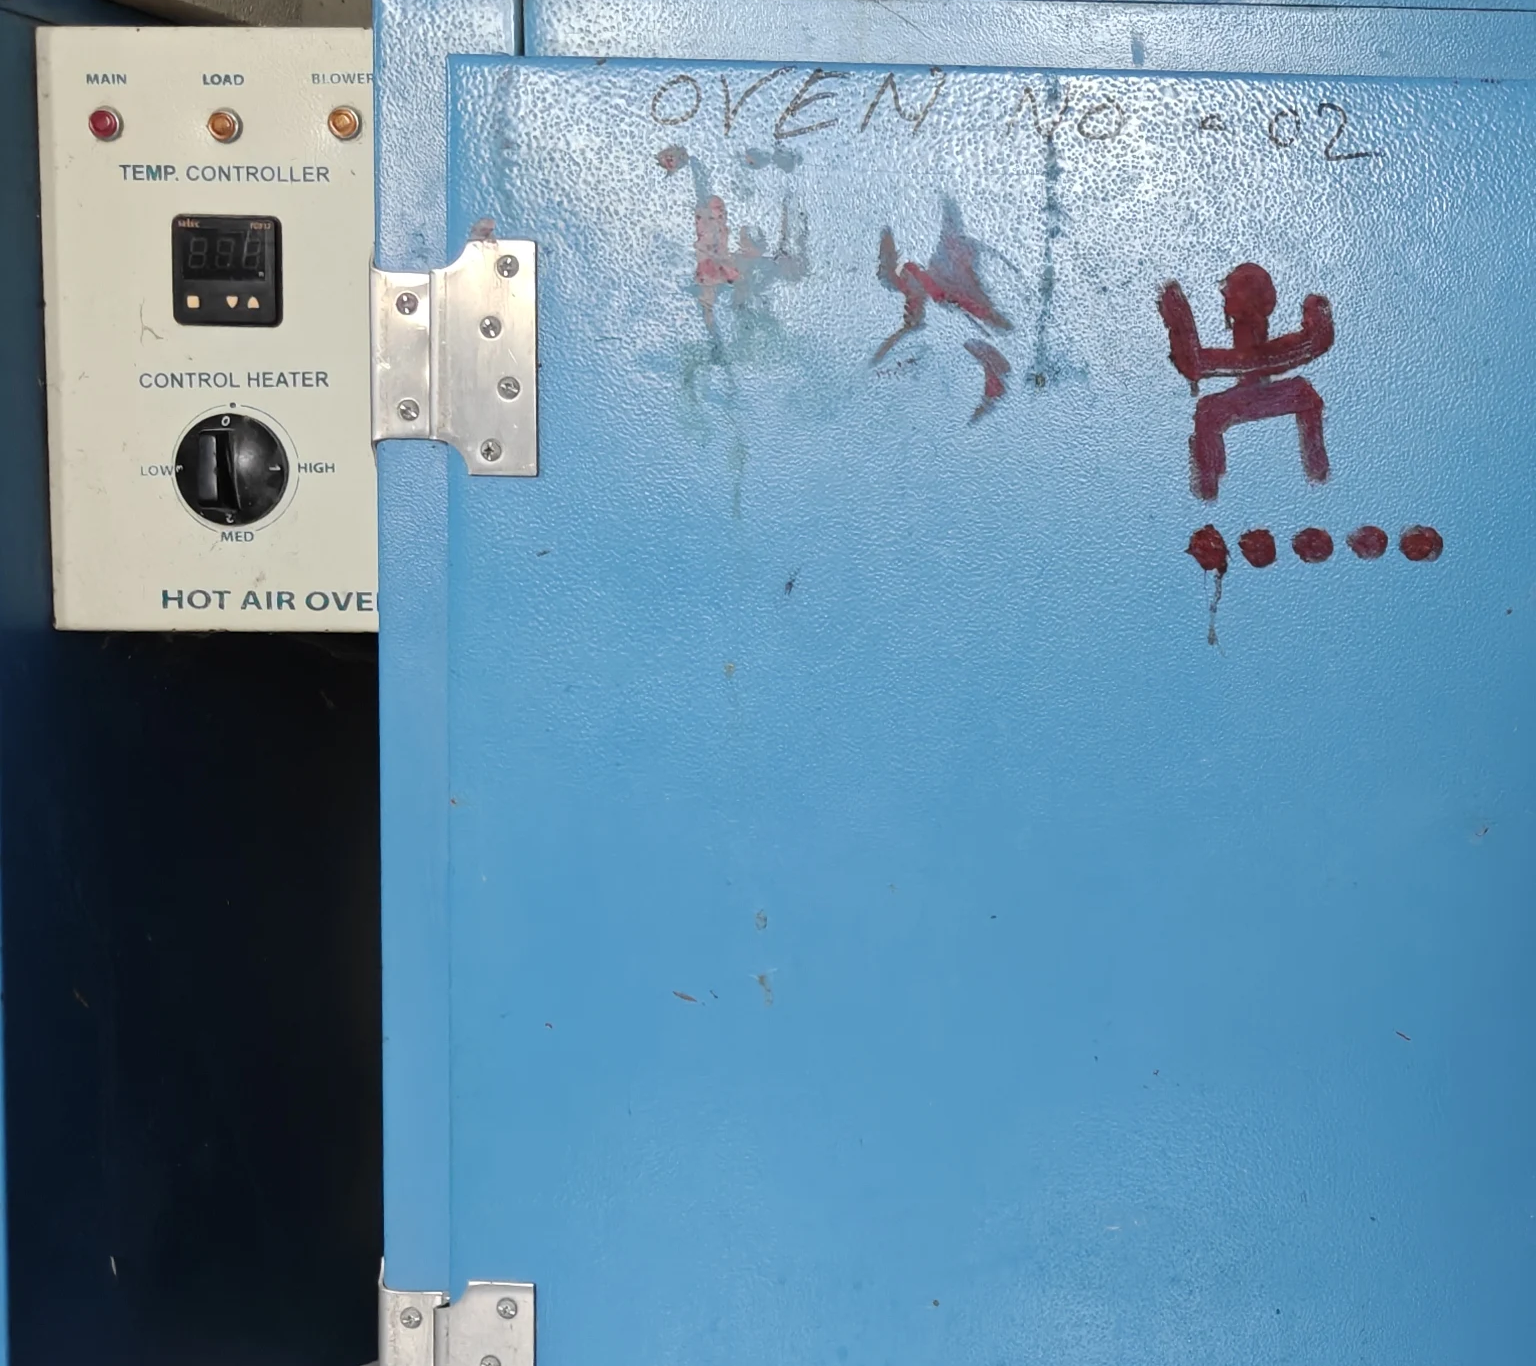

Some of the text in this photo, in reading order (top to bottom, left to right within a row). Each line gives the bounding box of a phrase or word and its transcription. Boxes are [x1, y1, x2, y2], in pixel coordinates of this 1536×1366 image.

[86, 73, 127, 85] MAIN
[202, 73, 244, 86] LOAD
[650, 66, 946, 139] OVEN
[1269, 103, 1385, 161] 02
[119, 165, 330, 183] TEMP. CONTROLLER
[139, 371, 329, 388] CONTROL HEATER
[140, 464, 174, 476] LOW
[298, 463, 335, 474] HIGH
[220, 531, 255, 542] MED
[161, 589, 379, 612] HOT AIR OVE
